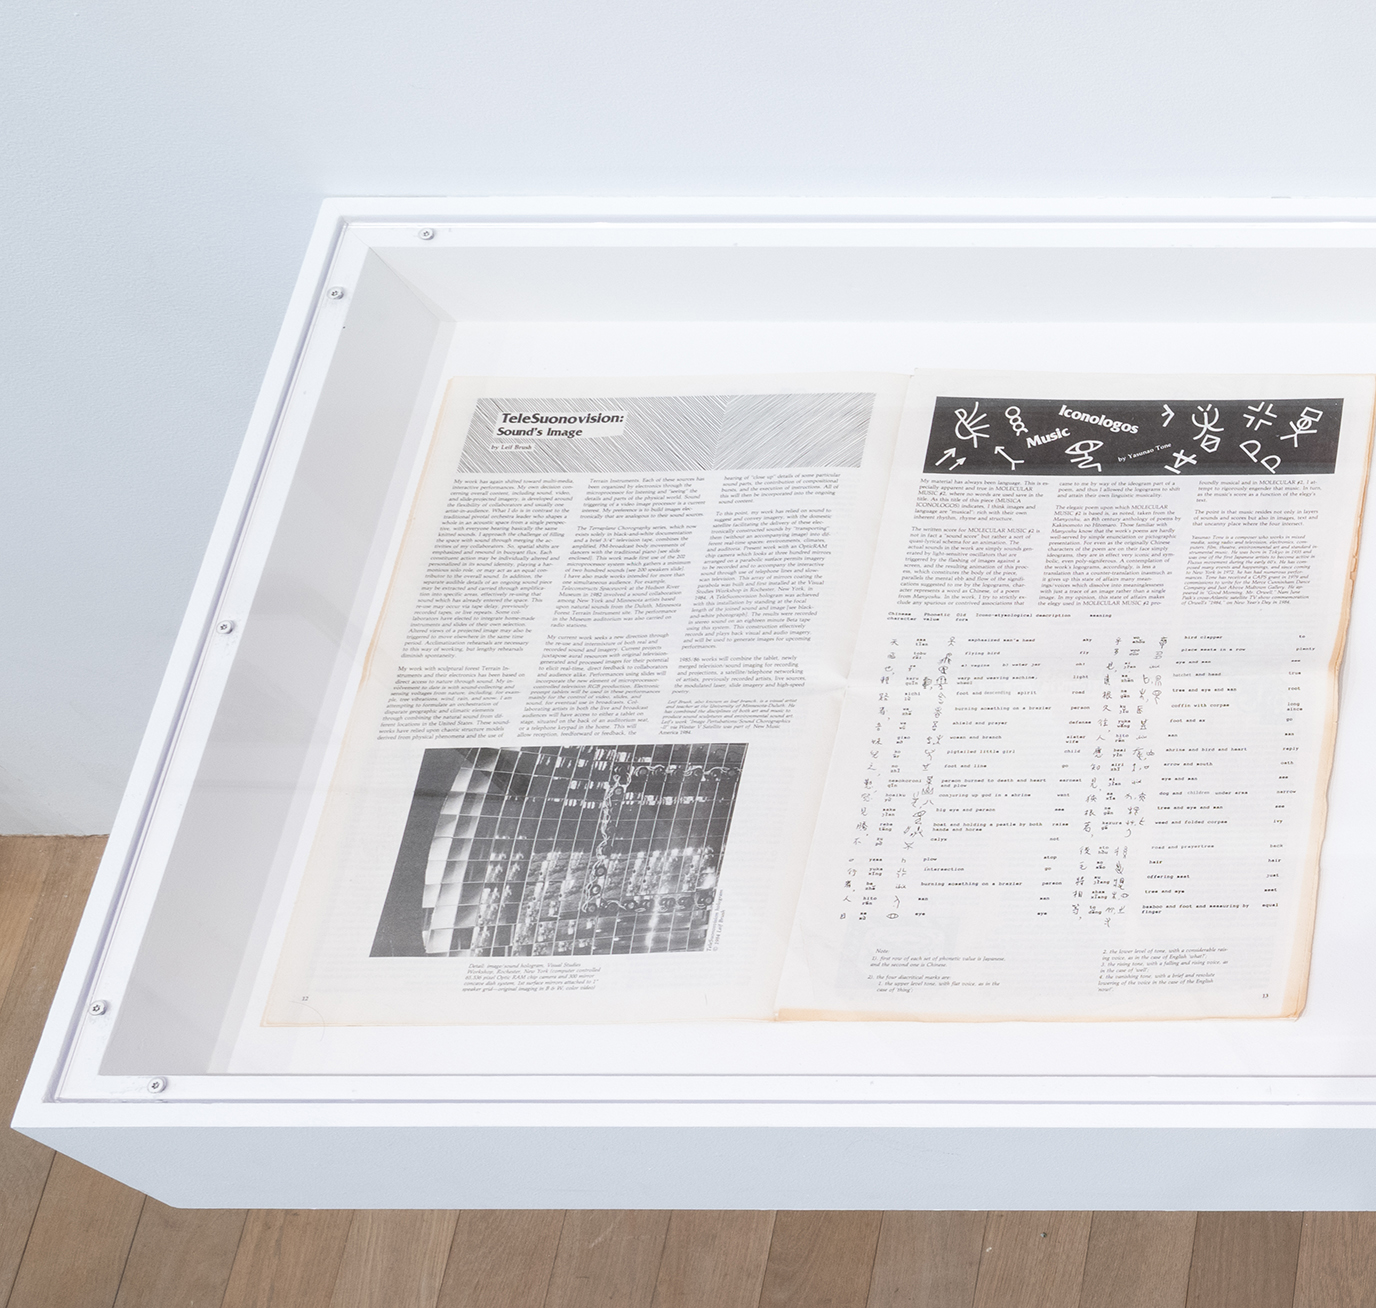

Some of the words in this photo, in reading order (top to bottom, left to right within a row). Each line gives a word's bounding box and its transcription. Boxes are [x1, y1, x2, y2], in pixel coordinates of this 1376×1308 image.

[502, 412, 624, 424] TeleSuonovision:
[1058, 404, 1139, 434] Iconologos
[497, 427, 542, 436] Sound's
[547, 427, 582, 438] Image
[1026, 428, 1071, 448] Music
[1128, 448, 1155, 459] Yasunao
